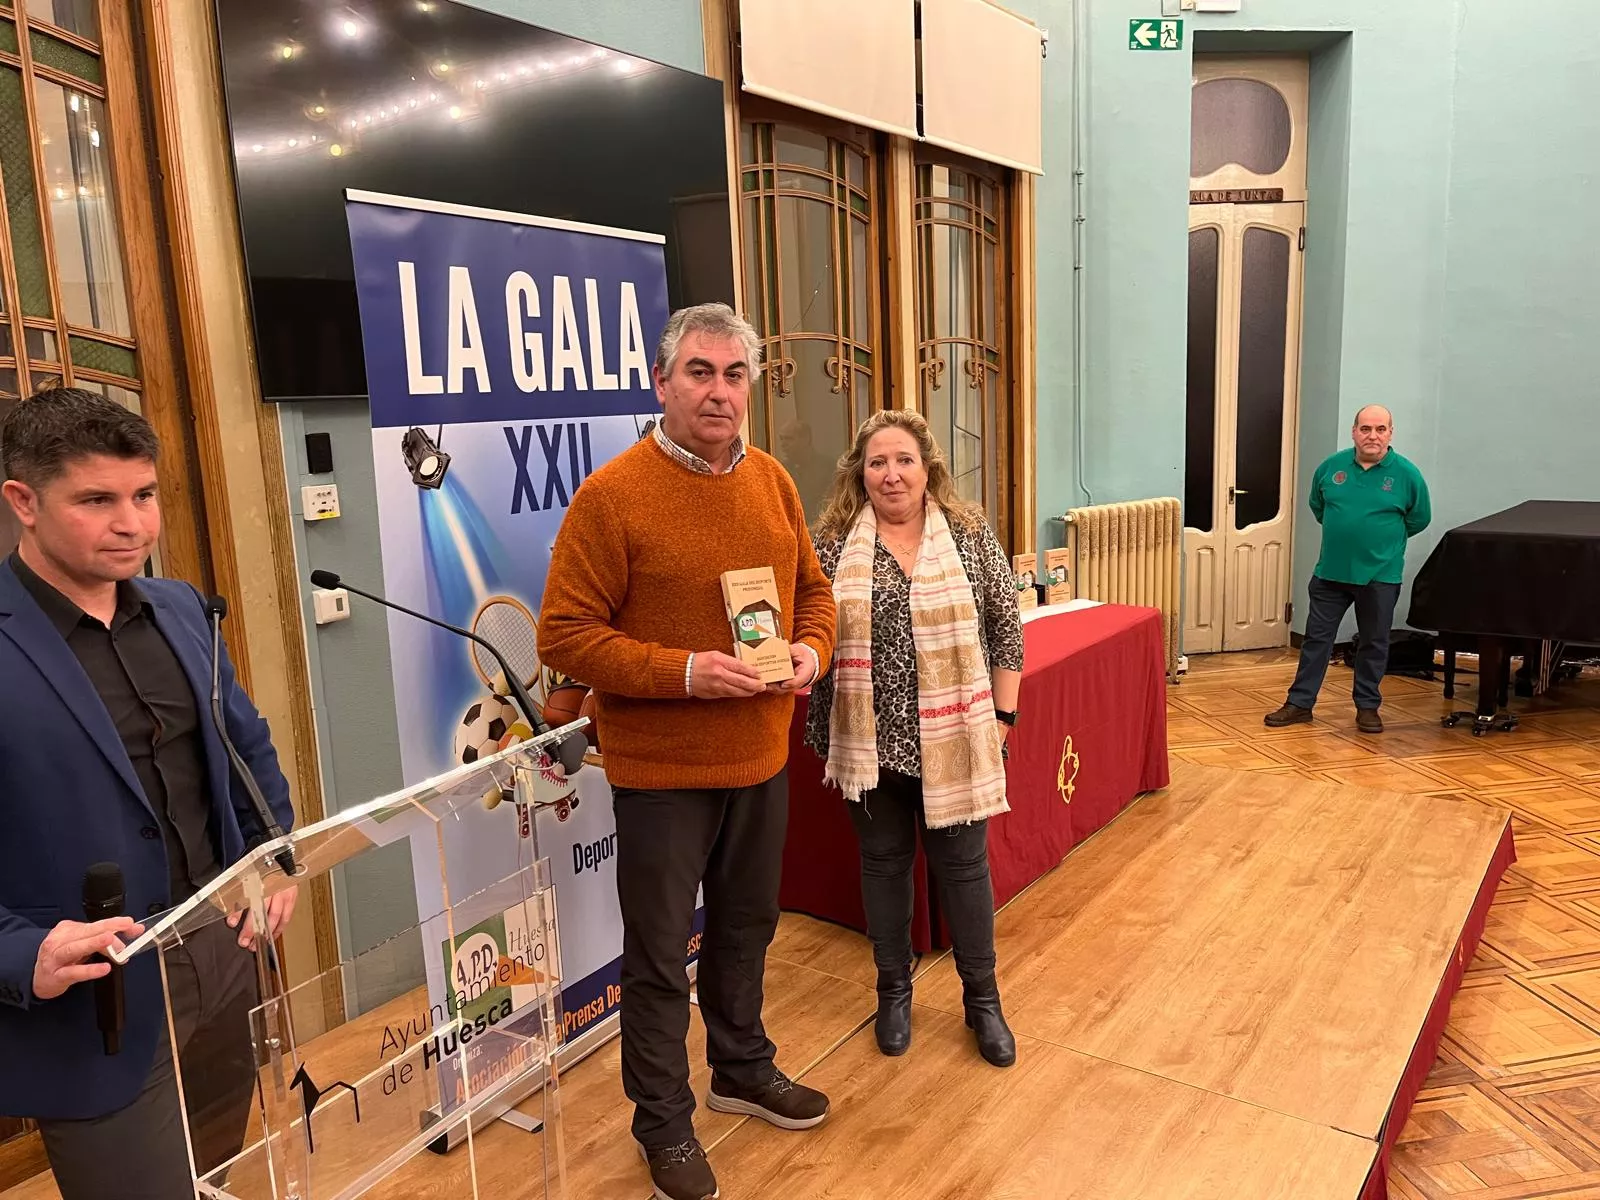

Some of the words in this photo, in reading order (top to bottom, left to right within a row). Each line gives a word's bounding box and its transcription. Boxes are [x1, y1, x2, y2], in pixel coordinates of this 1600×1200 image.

[1218, 191, 1232, 201] DE
[398, 261, 491, 395] LA
[505, 271, 651, 393] GALA
[503, 422, 593, 515] XXII
[379, 943, 545, 1060] Ayuntamiento
[382, 1063, 413, 1096] de
[422, 998, 513, 1071] Huesca
[456, 1042, 529, 1106] Aociación
[563, 996, 605, 1037] Prensa
